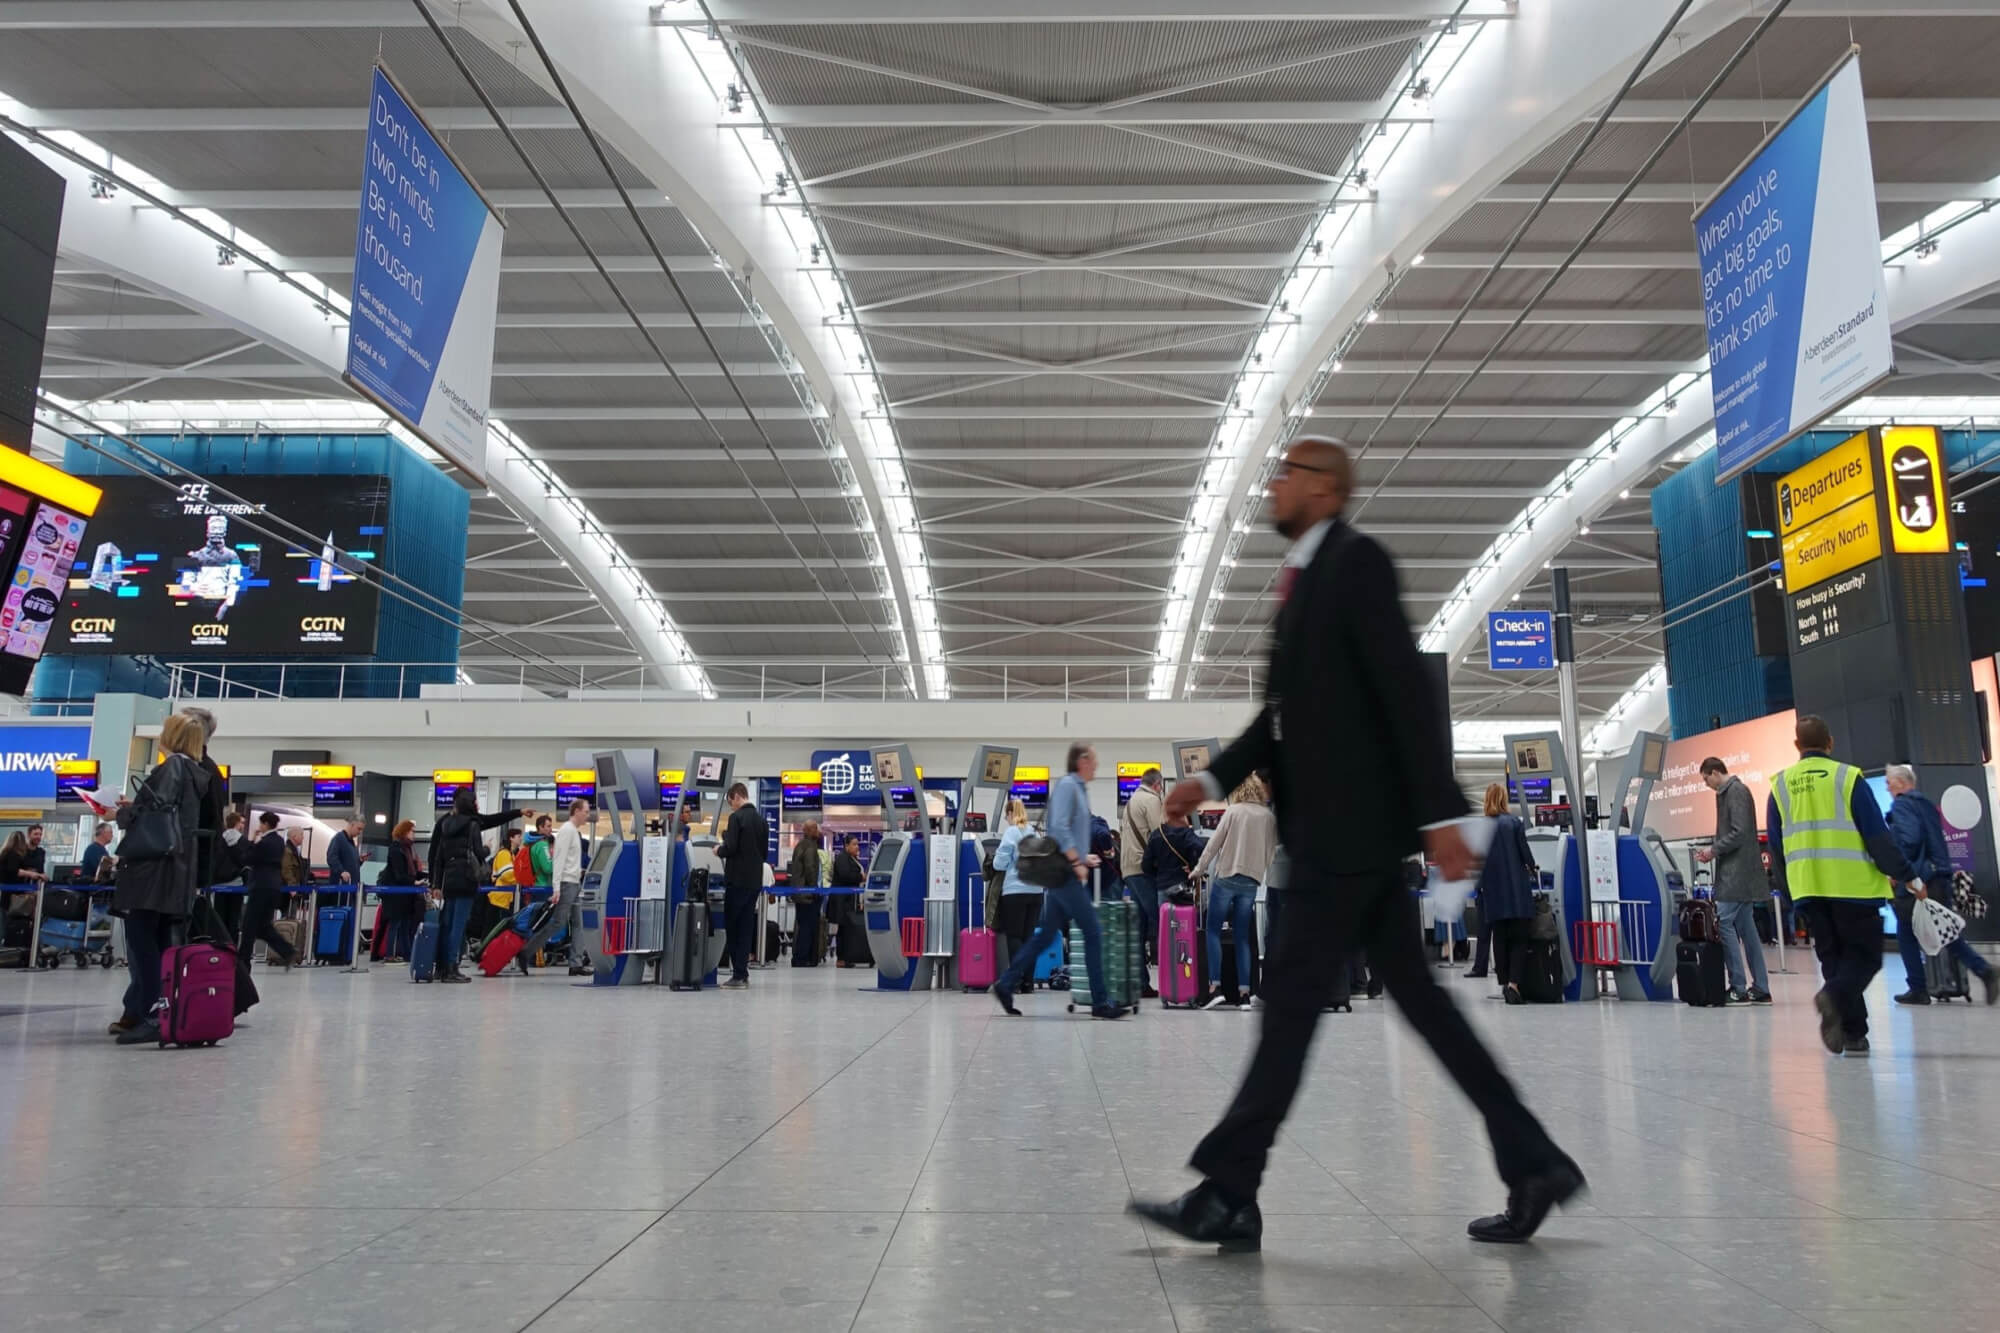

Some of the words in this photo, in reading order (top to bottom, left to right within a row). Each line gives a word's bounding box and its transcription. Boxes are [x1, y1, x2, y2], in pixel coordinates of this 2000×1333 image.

[376, 94, 410, 157] Don't
[411, 136, 427, 177] be
[429, 159, 440, 192] in
[372, 138, 396, 185] two
[399, 173, 436, 232] minds.
[368, 179, 386, 221] Be
[388, 201, 401, 237] in
[402, 224, 411, 248] a
[1700, 211, 1735, 257] When
[1736, 168, 1778, 231] you've
[364, 223, 424, 306] thousand.
[1704, 260, 1724, 301] got
[1724, 242, 1745, 274] big
[1746, 207, 1783, 262] goals,
[1706, 300, 1724, 330] it's
[1725, 286, 1742, 315] no
[1744, 258, 1774, 297] time
[1776, 243, 1791, 269] to
[1709, 323, 1741, 366] think
[1742, 290, 1779, 342] small.
[176, 483, 210, 502] SEE
[1793, 458, 1862, 508] Departures
[183, 504, 204, 515] THE
[1798, 538, 1836, 565] Security
[1838, 520, 1869, 547] North
[1796, 597, 1812, 611] How
[1811, 592, 1828, 604] busy
[1827, 585, 1834, 598] is
[1834, 572, 1866, 596] Security?
[70, 618, 116, 633] CGTN
[191, 624, 229, 637] CGTN
[300, 617, 346, 632] CGTN
[1494, 618, 1545, 632] Check-in
[1798, 613, 1817, 631] North
[1799, 629, 1819, 647] South
